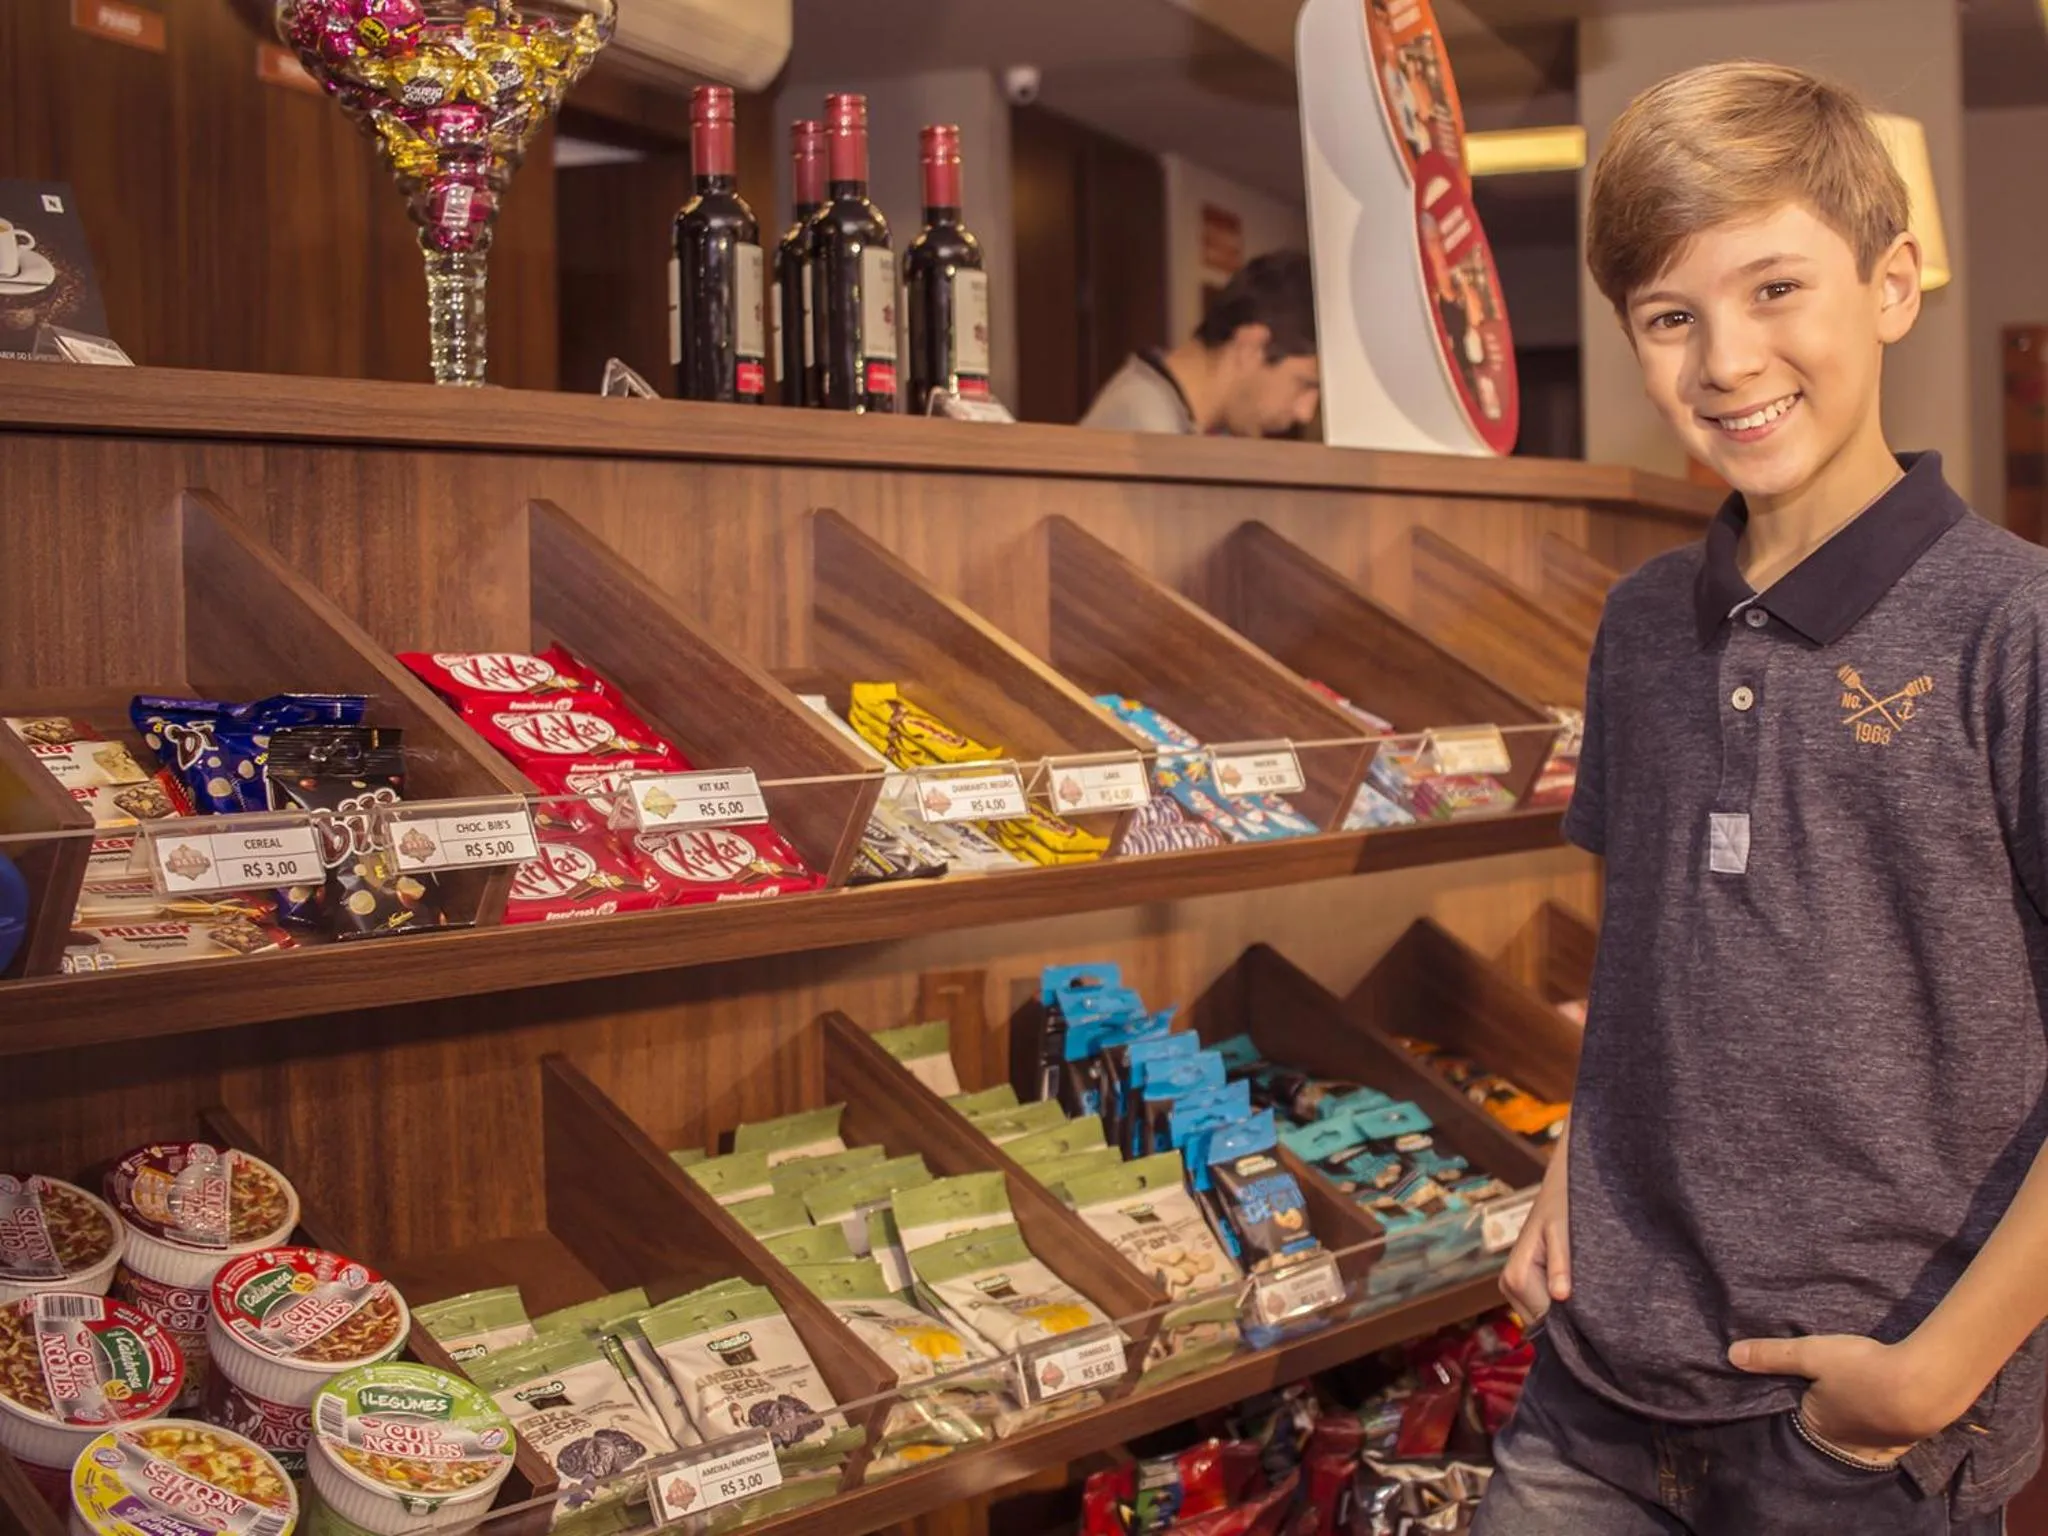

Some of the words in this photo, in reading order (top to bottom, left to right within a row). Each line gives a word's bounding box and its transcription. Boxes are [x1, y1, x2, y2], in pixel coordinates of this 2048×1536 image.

[462, 655, 545, 688] KitKat
[521, 714, 606, 749] KitKat
[1856, 722, 1891, 745] 1963
[698, 783, 711, 792] KIT
[714, 781, 730, 791] KAT
[699, 802, 716, 817] R$
[719, 801, 744, 816] 6,00
[244, 837, 283, 850] CEREAL
[465, 843, 483, 859] R$
[486, 840, 515, 858] 5,00
[663, 832, 747, 877] KitKat
[243, 862, 263, 878] R$
[265, 860, 298, 878] 3,00
[283, 1298, 321, 1325] CUP
[286, 1299, 353, 1342] NOODLES
[40, 1333, 79, 1399] NOODLES
[720, 1378, 773, 1395] SECA
[368, 1392, 448, 1412] LEGUMES
[384, 1423, 442, 1444] CUP
[527, 1416, 588, 1444] SECA
[363, 1434, 464, 1460] NOODLES
[143, 1460, 247, 1516] NOODLES
[720, 1480, 737, 1497] R$
[739, 1473, 763, 1492] 3,00
